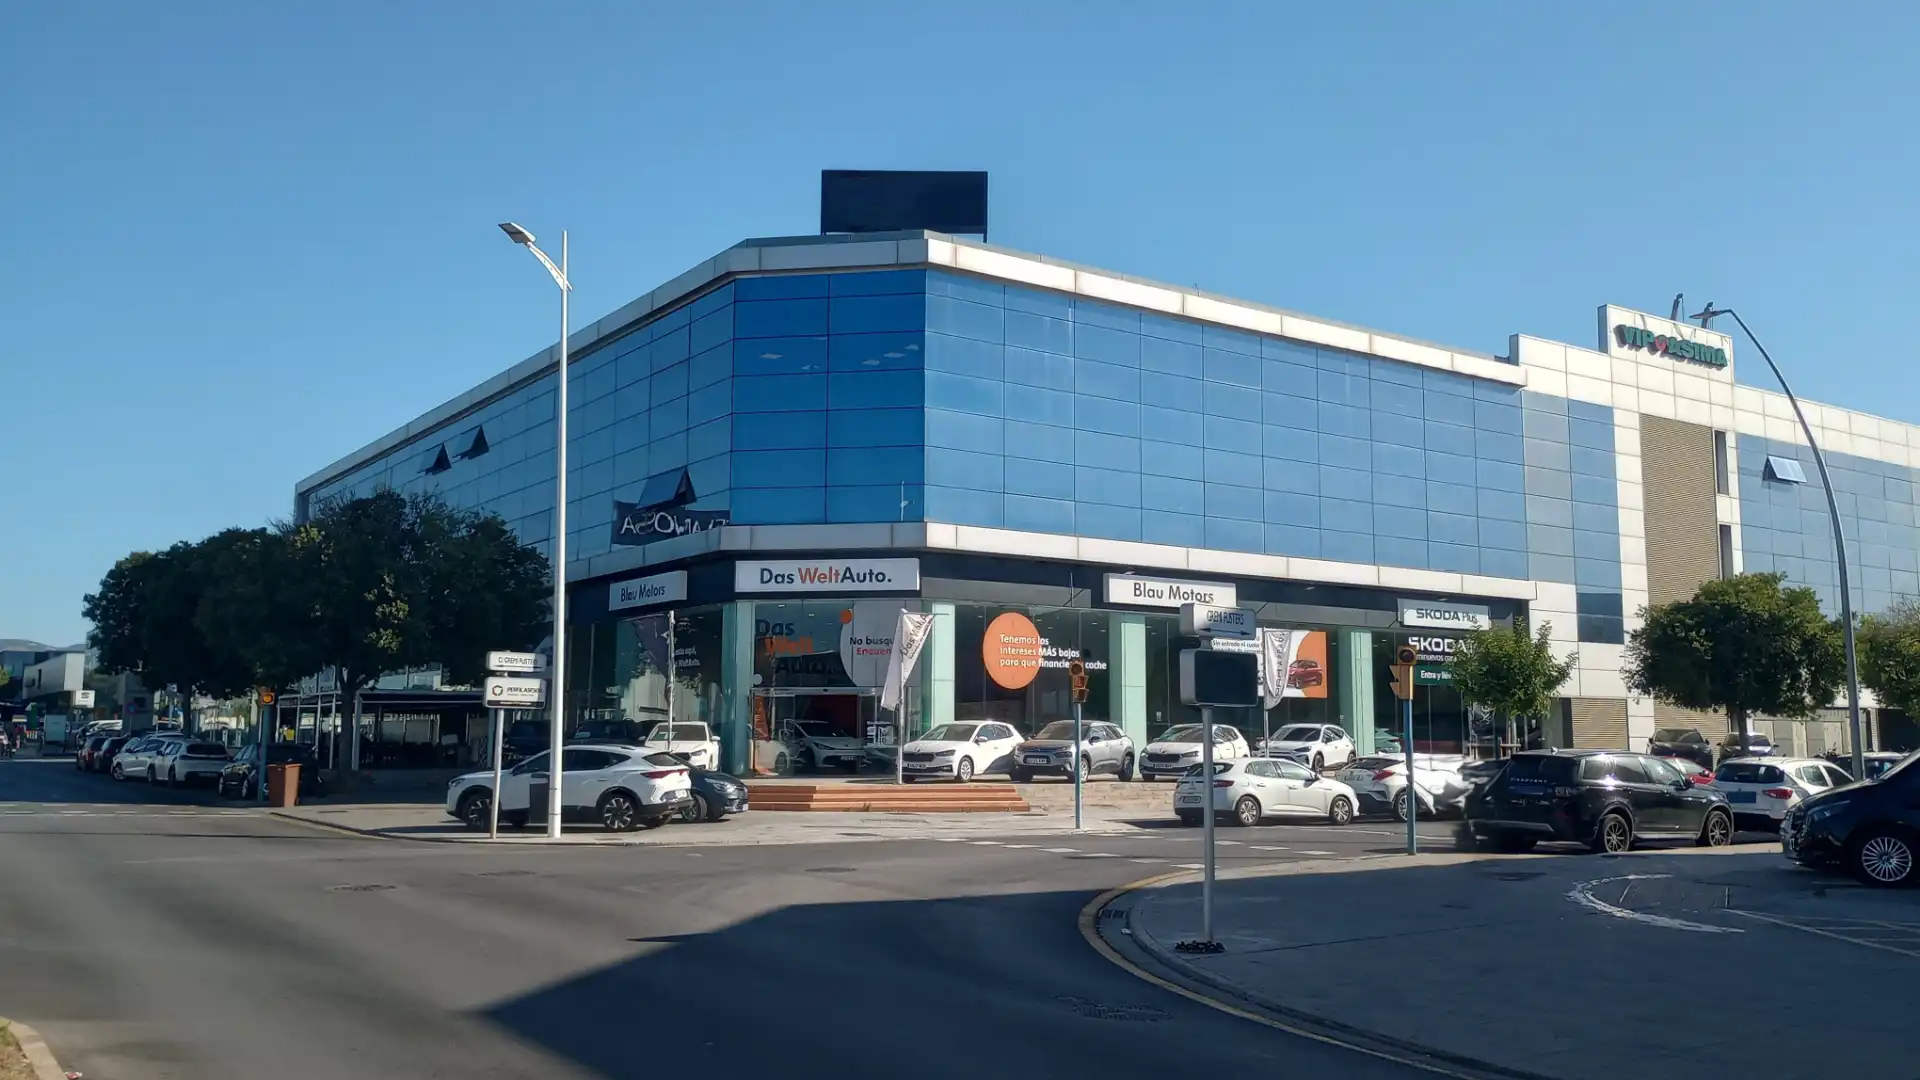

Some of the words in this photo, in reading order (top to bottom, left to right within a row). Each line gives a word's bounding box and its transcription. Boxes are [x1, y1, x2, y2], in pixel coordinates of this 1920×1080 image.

[1622, 326, 1655, 346] VIP
[1668, 337, 1728, 366] ASIMA
[760, 567, 795, 584] Das
[620, 588, 637, 602] Blau
[639, 583, 666, 599] Motors
[1133, 582, 1164, 599] Blau
[1168, 585, 1214, 603] Motors
[849, 636, 863, 645] No
[1000, 633, 1036, 644] Tenemos
[1037, 635, 1049, 646] los
[1000, 646, 1037, 656] intereses
[1038, 645, 1057, 657] MÁS
[1058, 648, 1080, 659] bajos
[1000, 659, 1019, 670] para
[1021, 661, 1039, 670] que
[1038, 658, 1071, 669] financie
[1085, 660, 1107, 670] coche
[1420, 670, 1436, 679] Entra
